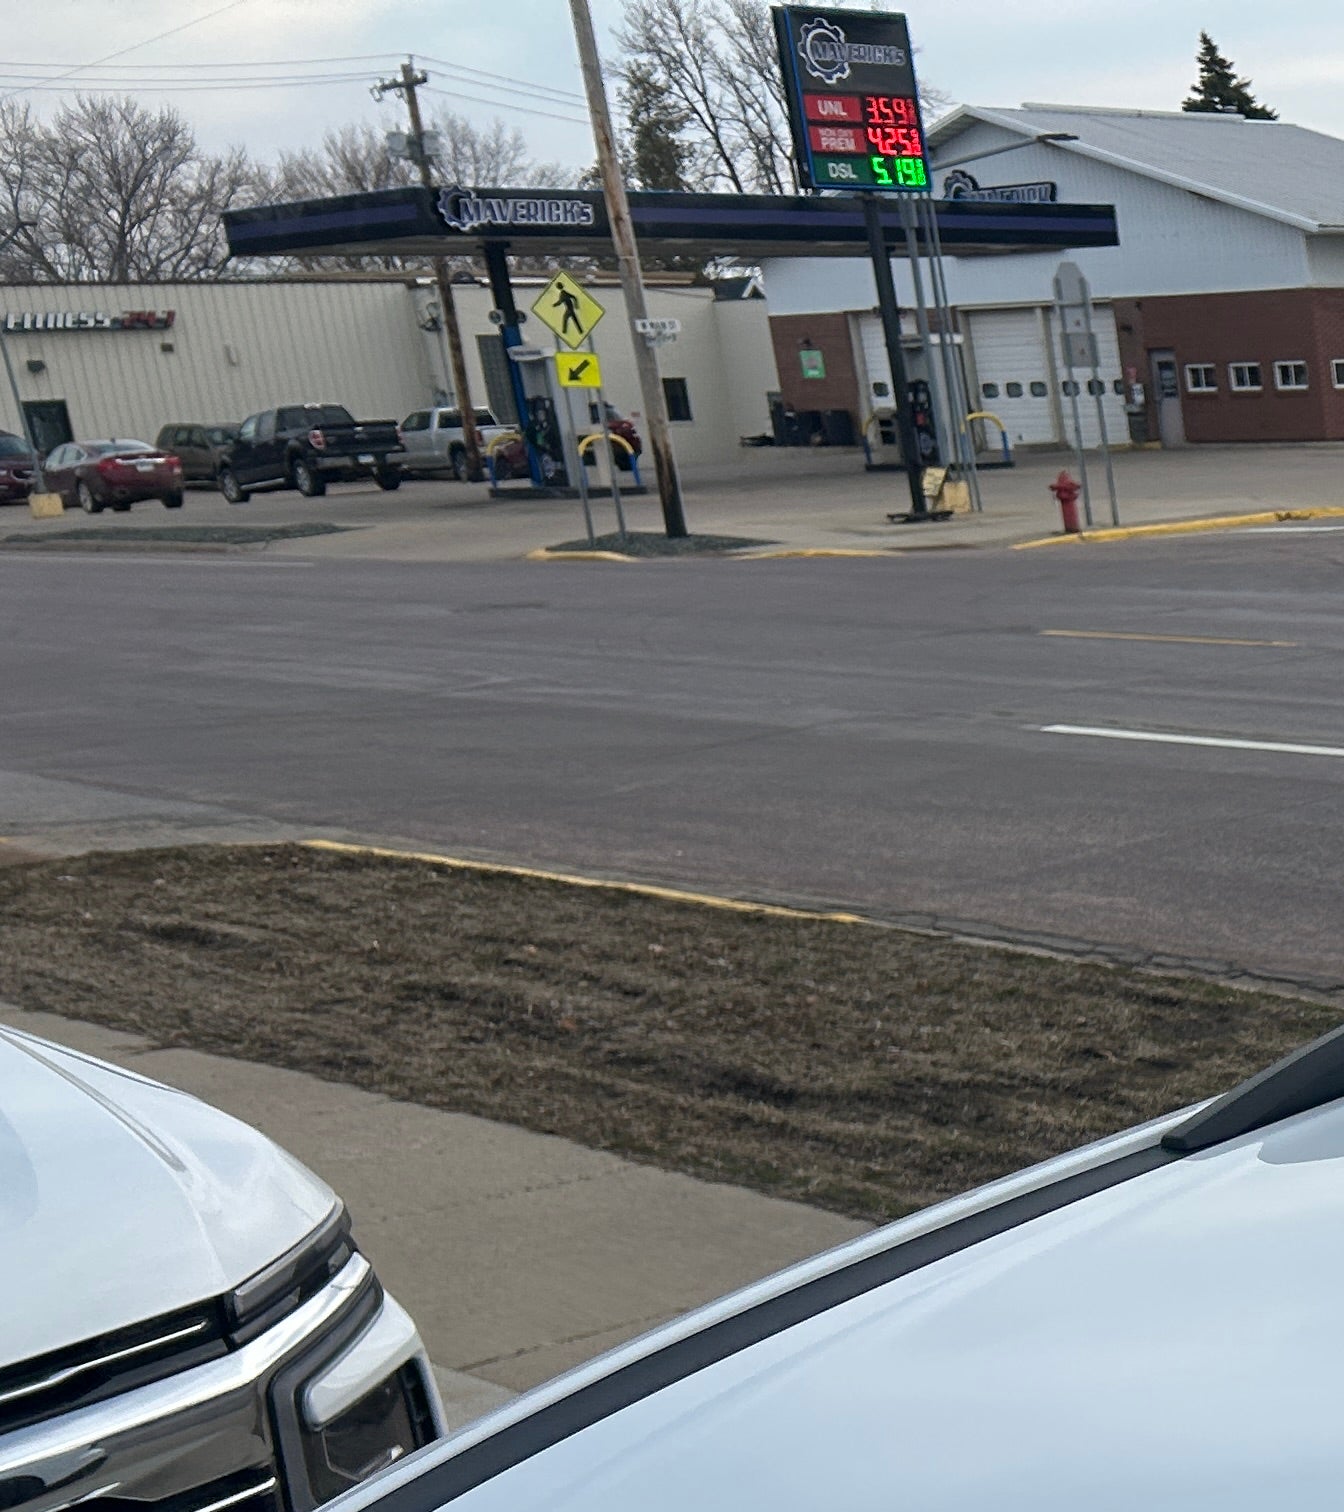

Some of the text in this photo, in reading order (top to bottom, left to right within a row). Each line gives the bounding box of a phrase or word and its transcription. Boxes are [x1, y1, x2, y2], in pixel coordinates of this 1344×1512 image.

[817, 99, 848, 116] UNL
[821, 137, 856, 150] PREM
[828, 162, 858, 179] DSL
